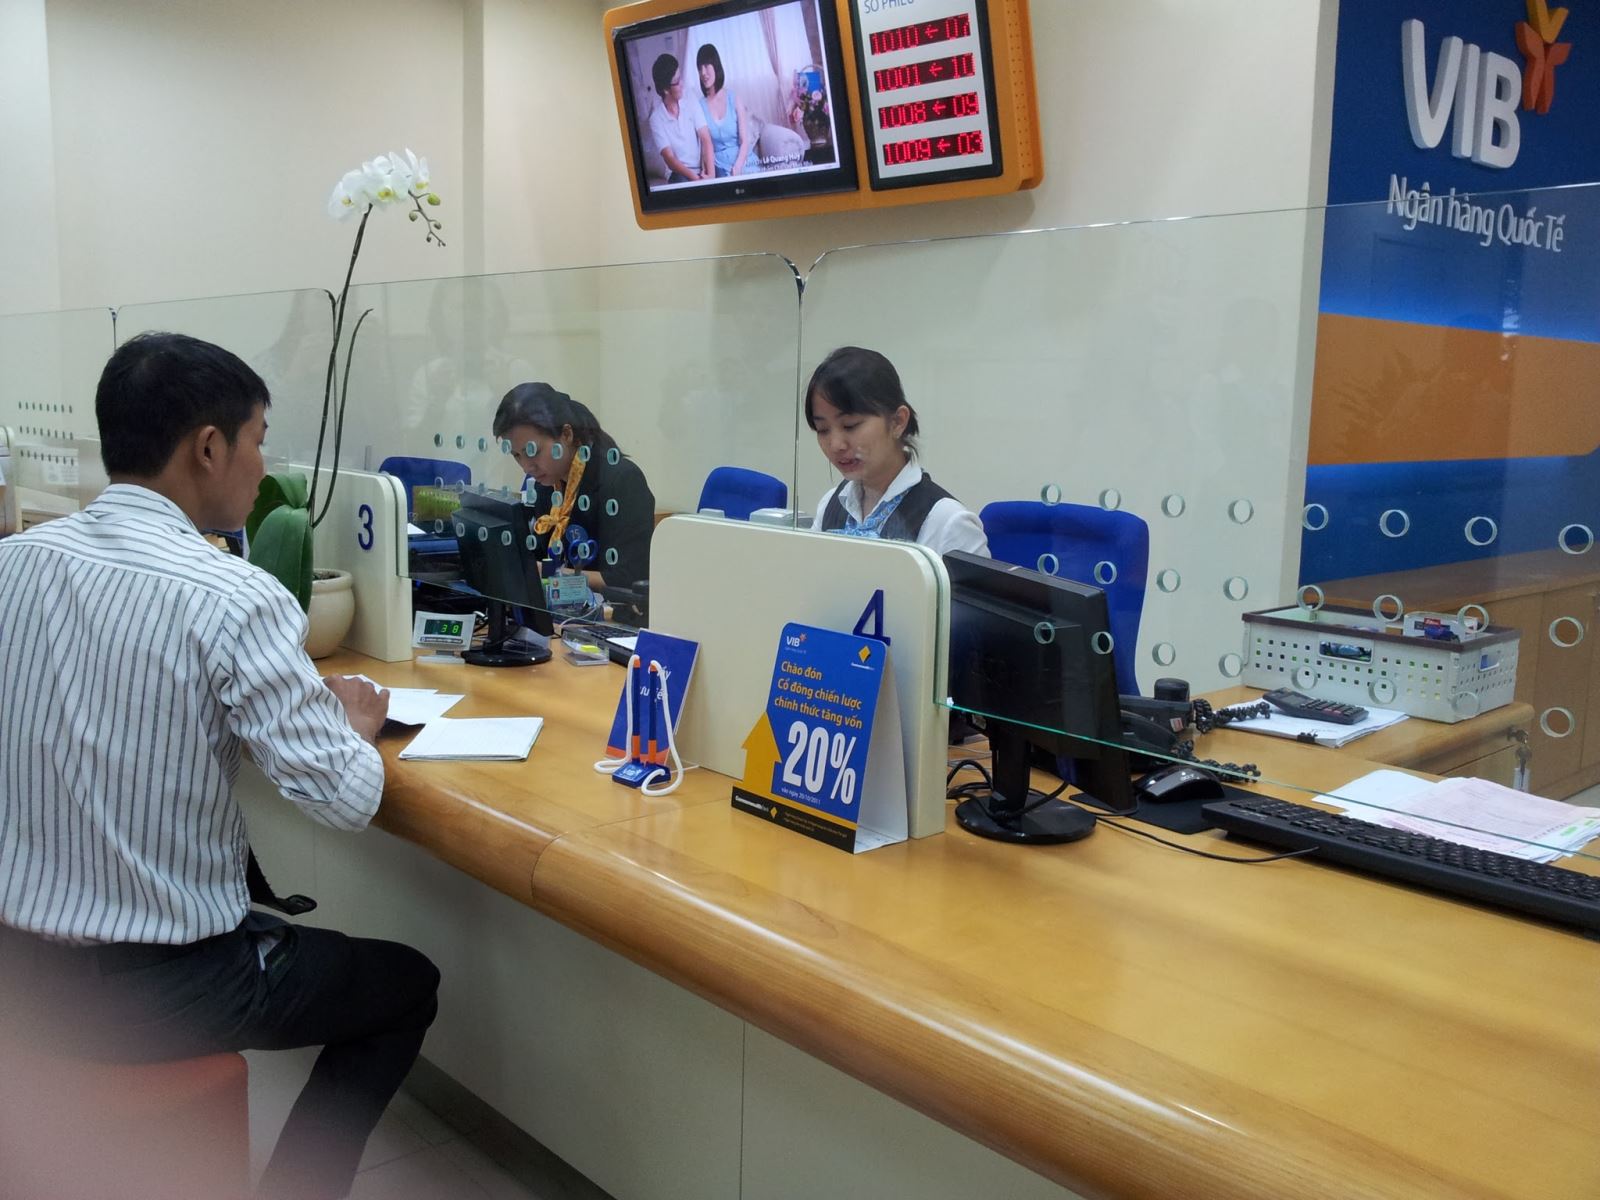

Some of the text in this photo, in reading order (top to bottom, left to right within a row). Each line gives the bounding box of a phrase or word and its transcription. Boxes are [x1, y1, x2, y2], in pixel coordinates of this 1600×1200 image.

[871, 13, 970, 55] 1010 07
[876, 52, 976, 93] 1001 10
[880, 92, 979, 129] 1008 09
[1401, 18, 1522, 169] VIB
[885, 130, 984, 165] 1009 03
[1387, 174, 1566, 252] Ngân hàng Quốc Tế
[358, 504, 374, 551] 3
[852, 589, 891, 647] 4
[786, 636, 800, 647] VIB
[781, 660, 823, 680] Chào đón
[774, 695, 863, 729] chính thức tăng vốn
[814, 688, 840, 705] chiến
[841, 693, 863, 711] lược
[782, 720, 858, 805] 20%
